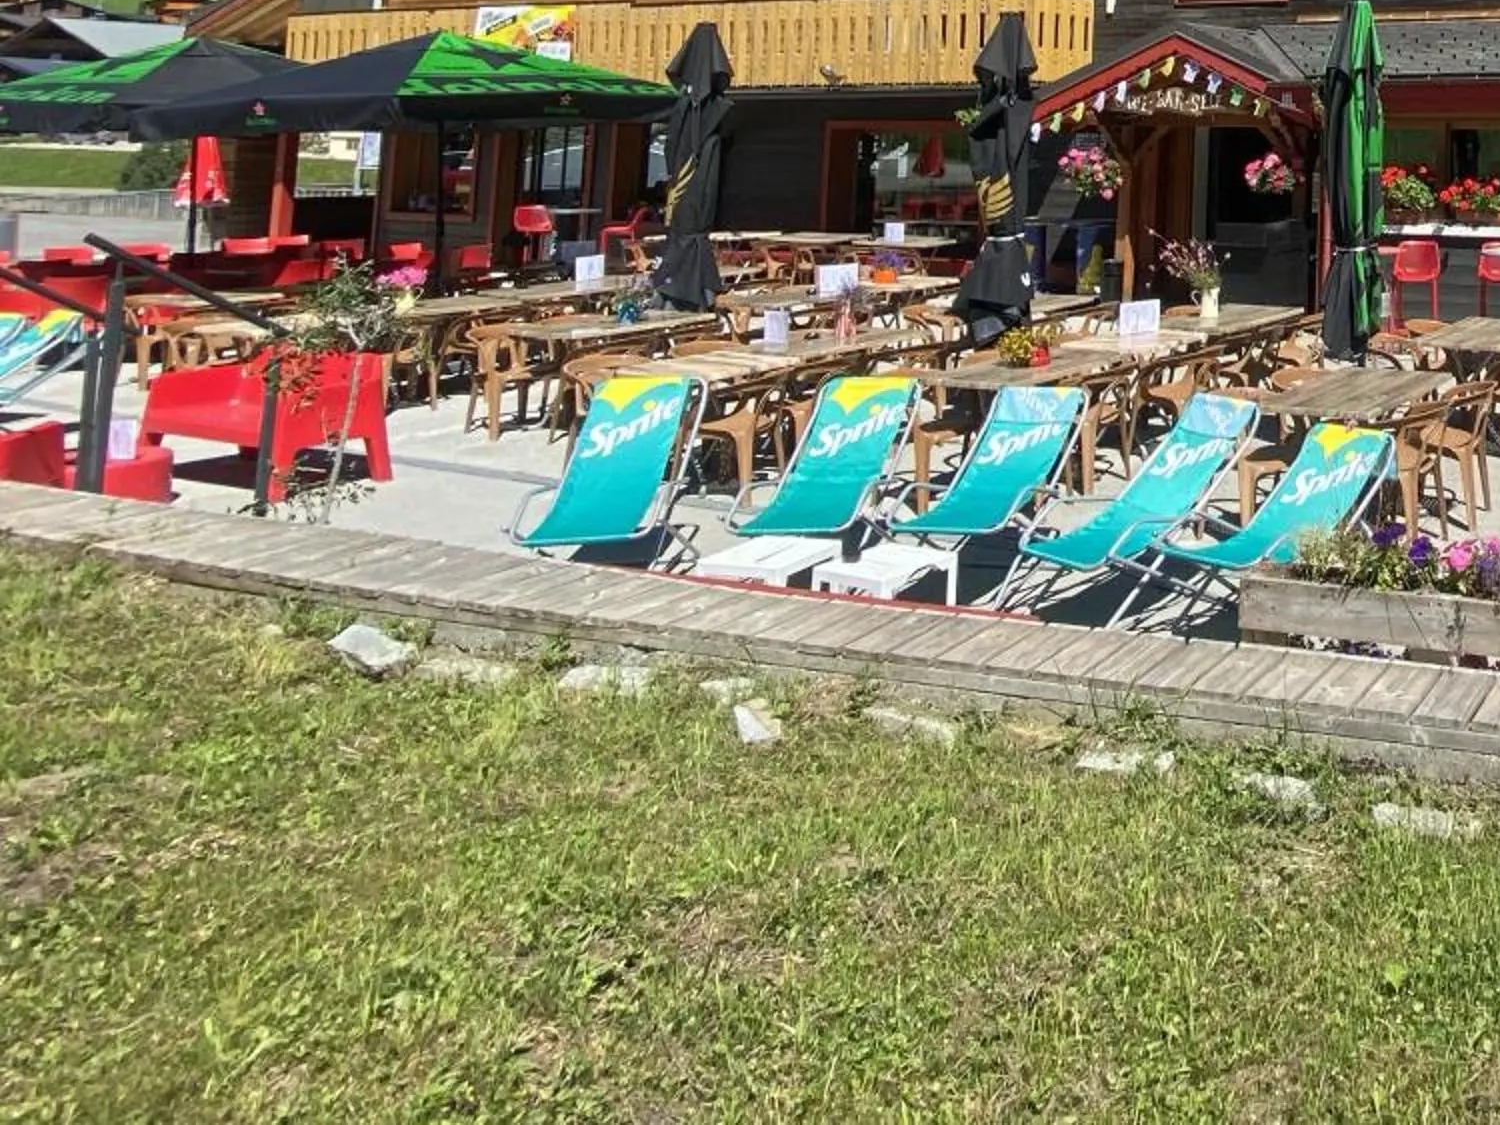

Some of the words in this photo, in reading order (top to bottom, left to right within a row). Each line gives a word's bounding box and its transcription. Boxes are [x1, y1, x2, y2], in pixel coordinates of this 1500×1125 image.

[580, 395, 682, 458] Sprite
[808, 402, 910, 458] Sprite
[1280, 451, 1380, 506] Sprite
